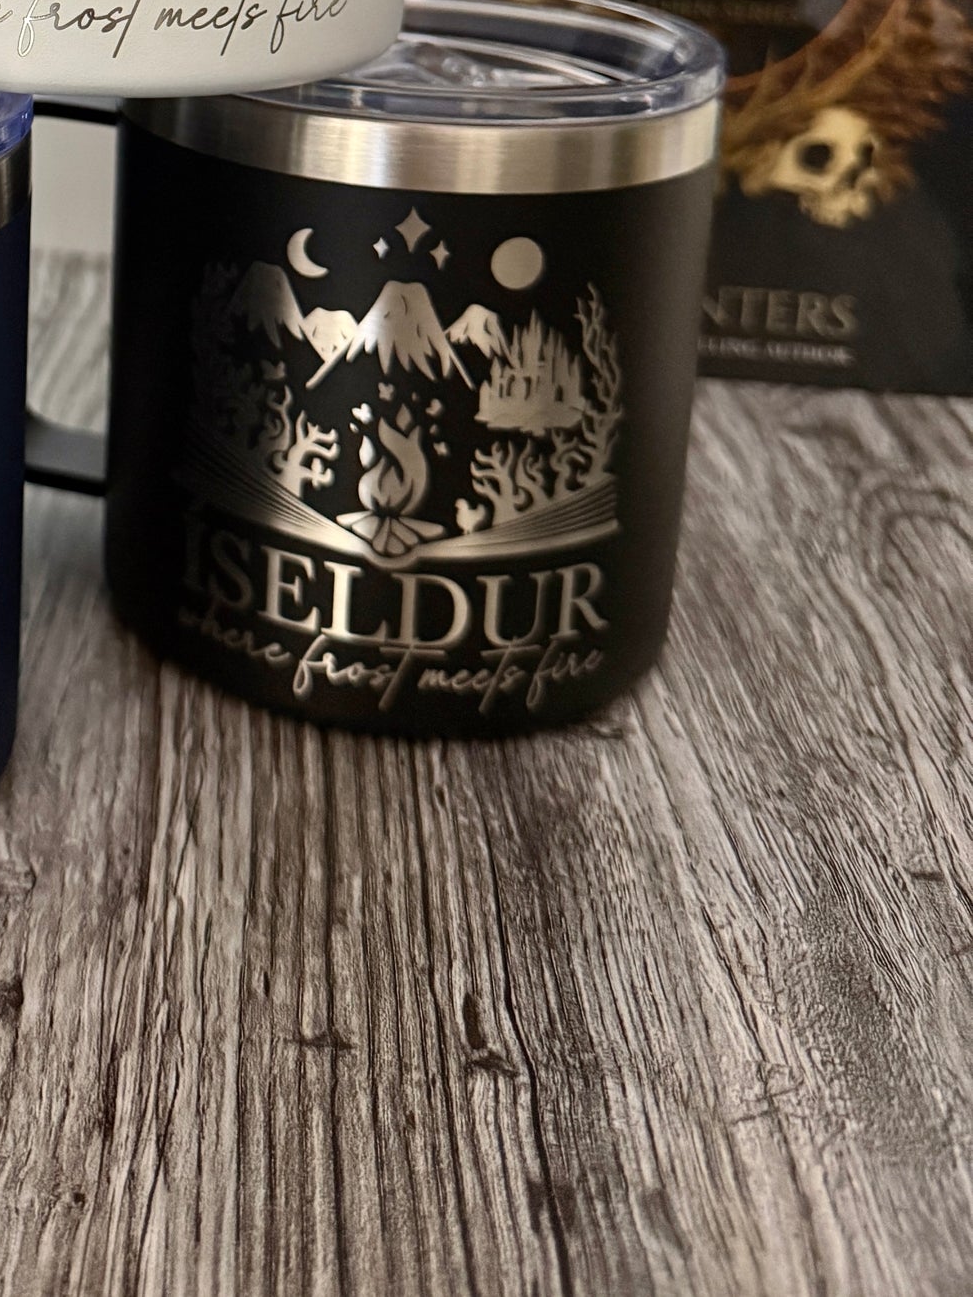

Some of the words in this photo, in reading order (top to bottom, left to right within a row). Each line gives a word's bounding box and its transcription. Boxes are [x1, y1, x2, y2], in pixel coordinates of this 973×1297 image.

[292, 635, 448, 712] frost
[418, 636, 540, 713] meets
[526, 640, 604, 712] fire
